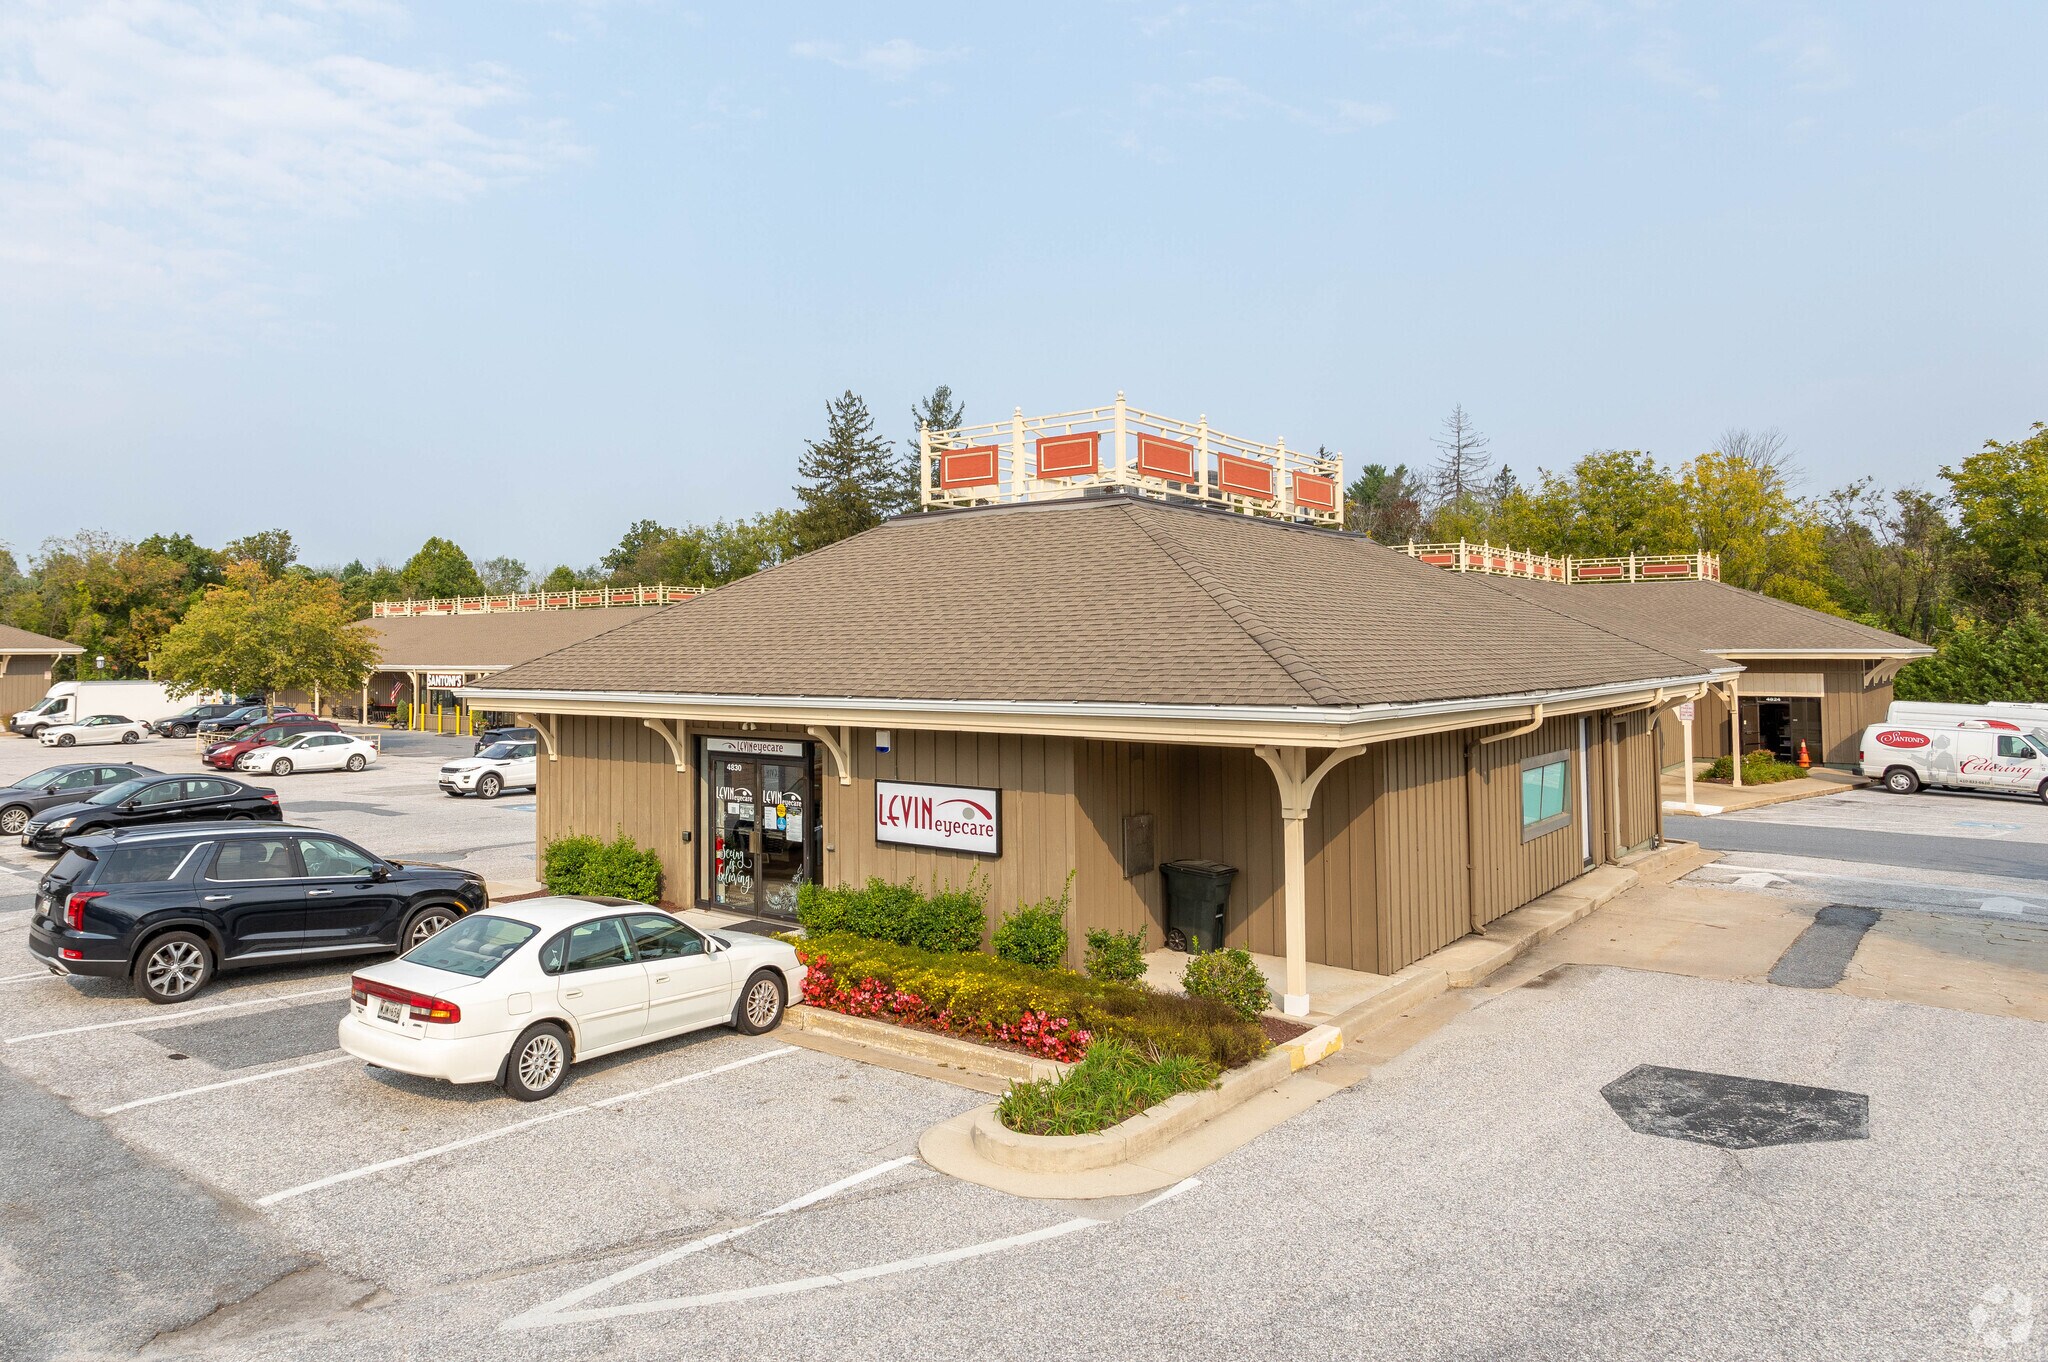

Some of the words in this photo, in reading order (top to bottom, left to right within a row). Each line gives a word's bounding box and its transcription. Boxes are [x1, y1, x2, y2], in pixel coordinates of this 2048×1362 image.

[428, 674, 462, 687] SANTONI'S
[726, 763, 742, 771] 4830
[716, 786, 735, 799] LEVIN
[763, 790, 782, 804] LEVIN
[879, 793, 933, 830] LEVIN
[935, 820, 994, 838] eyecare
